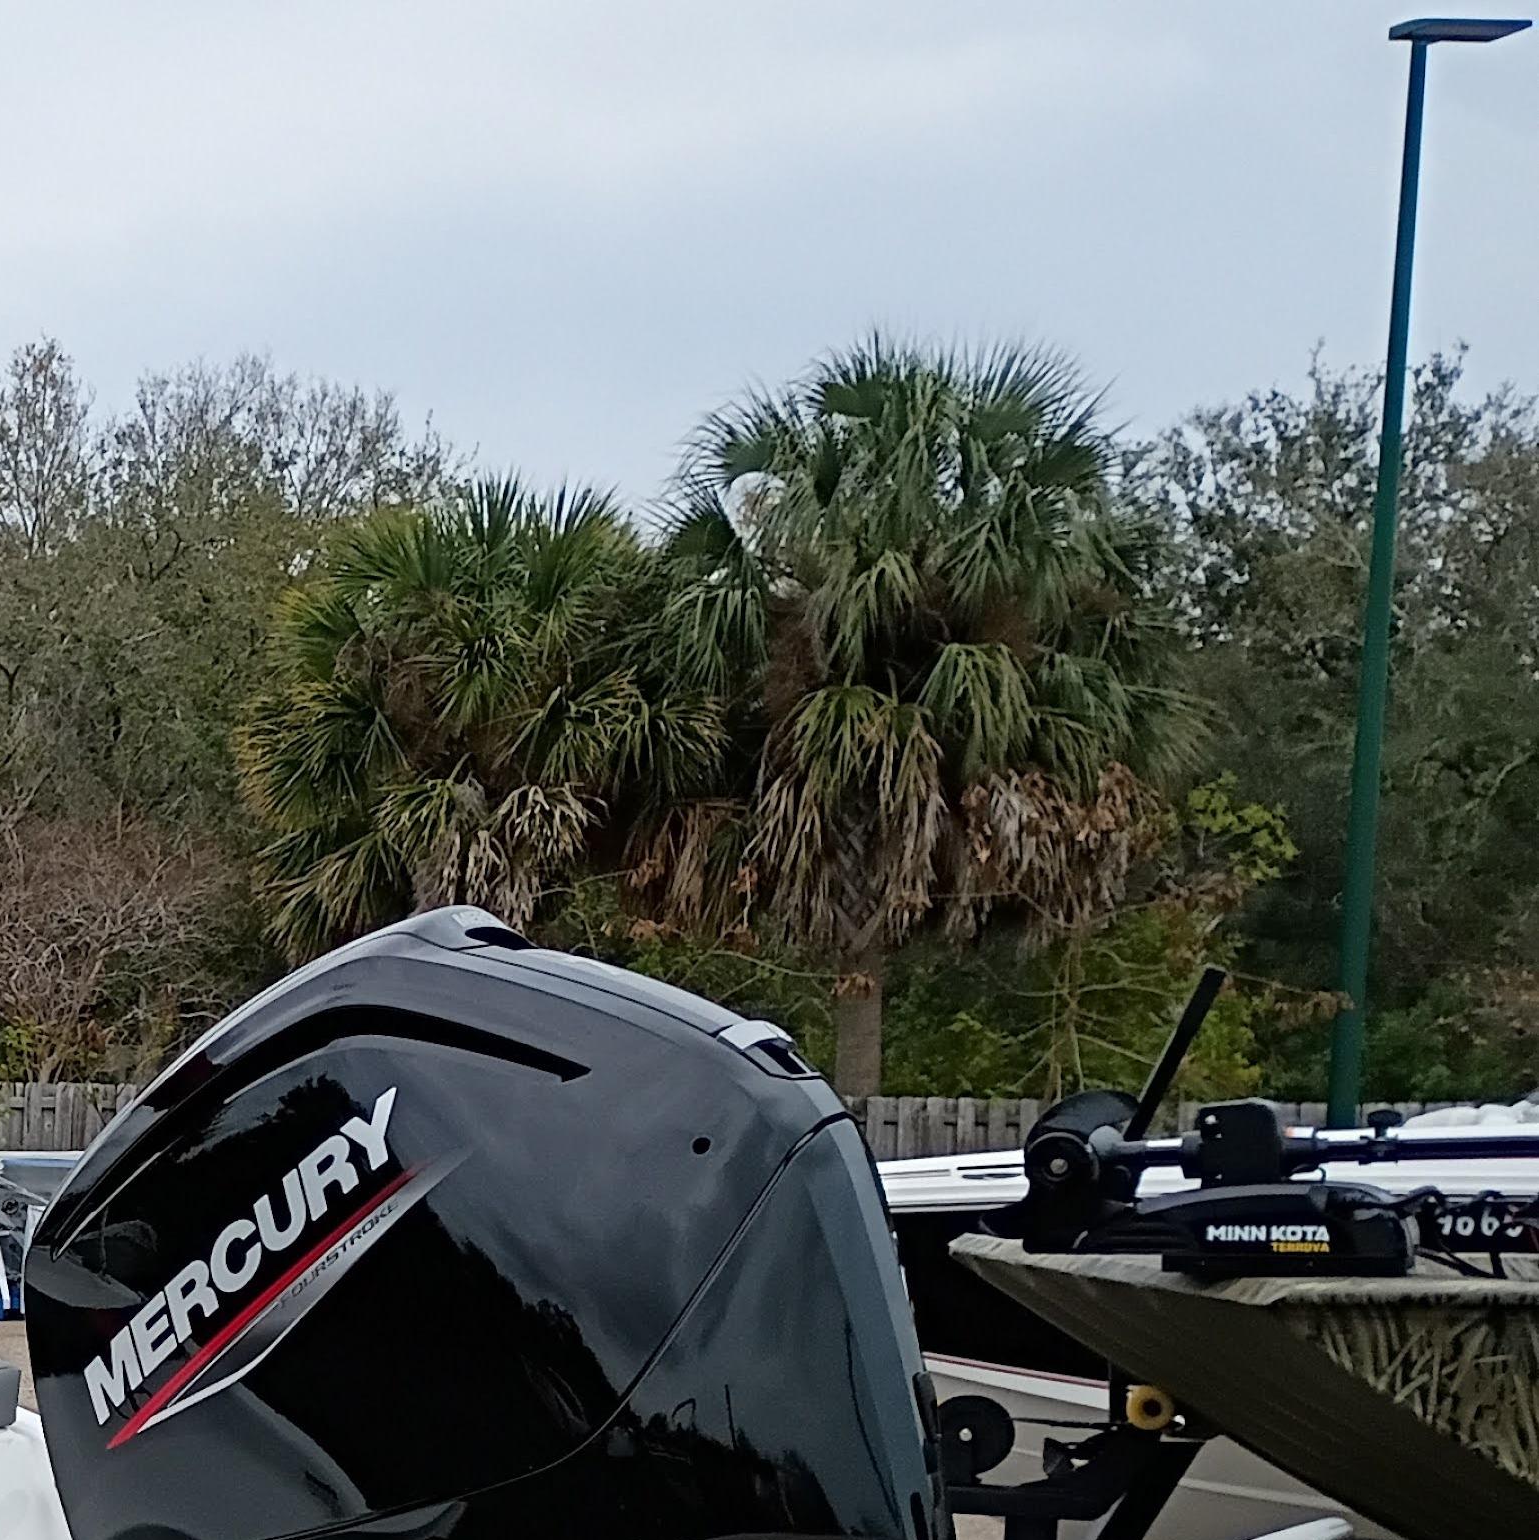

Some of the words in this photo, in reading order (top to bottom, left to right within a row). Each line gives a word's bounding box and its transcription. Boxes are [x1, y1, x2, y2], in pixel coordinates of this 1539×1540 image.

[83, 1086, 398, 1426] MERCURY
[276, 1200, 399, 1310] FOURSTROKE
[1206, 1225, 1267, 1242] MINN
[1270, 1225, 1330, 1242] KOTA
